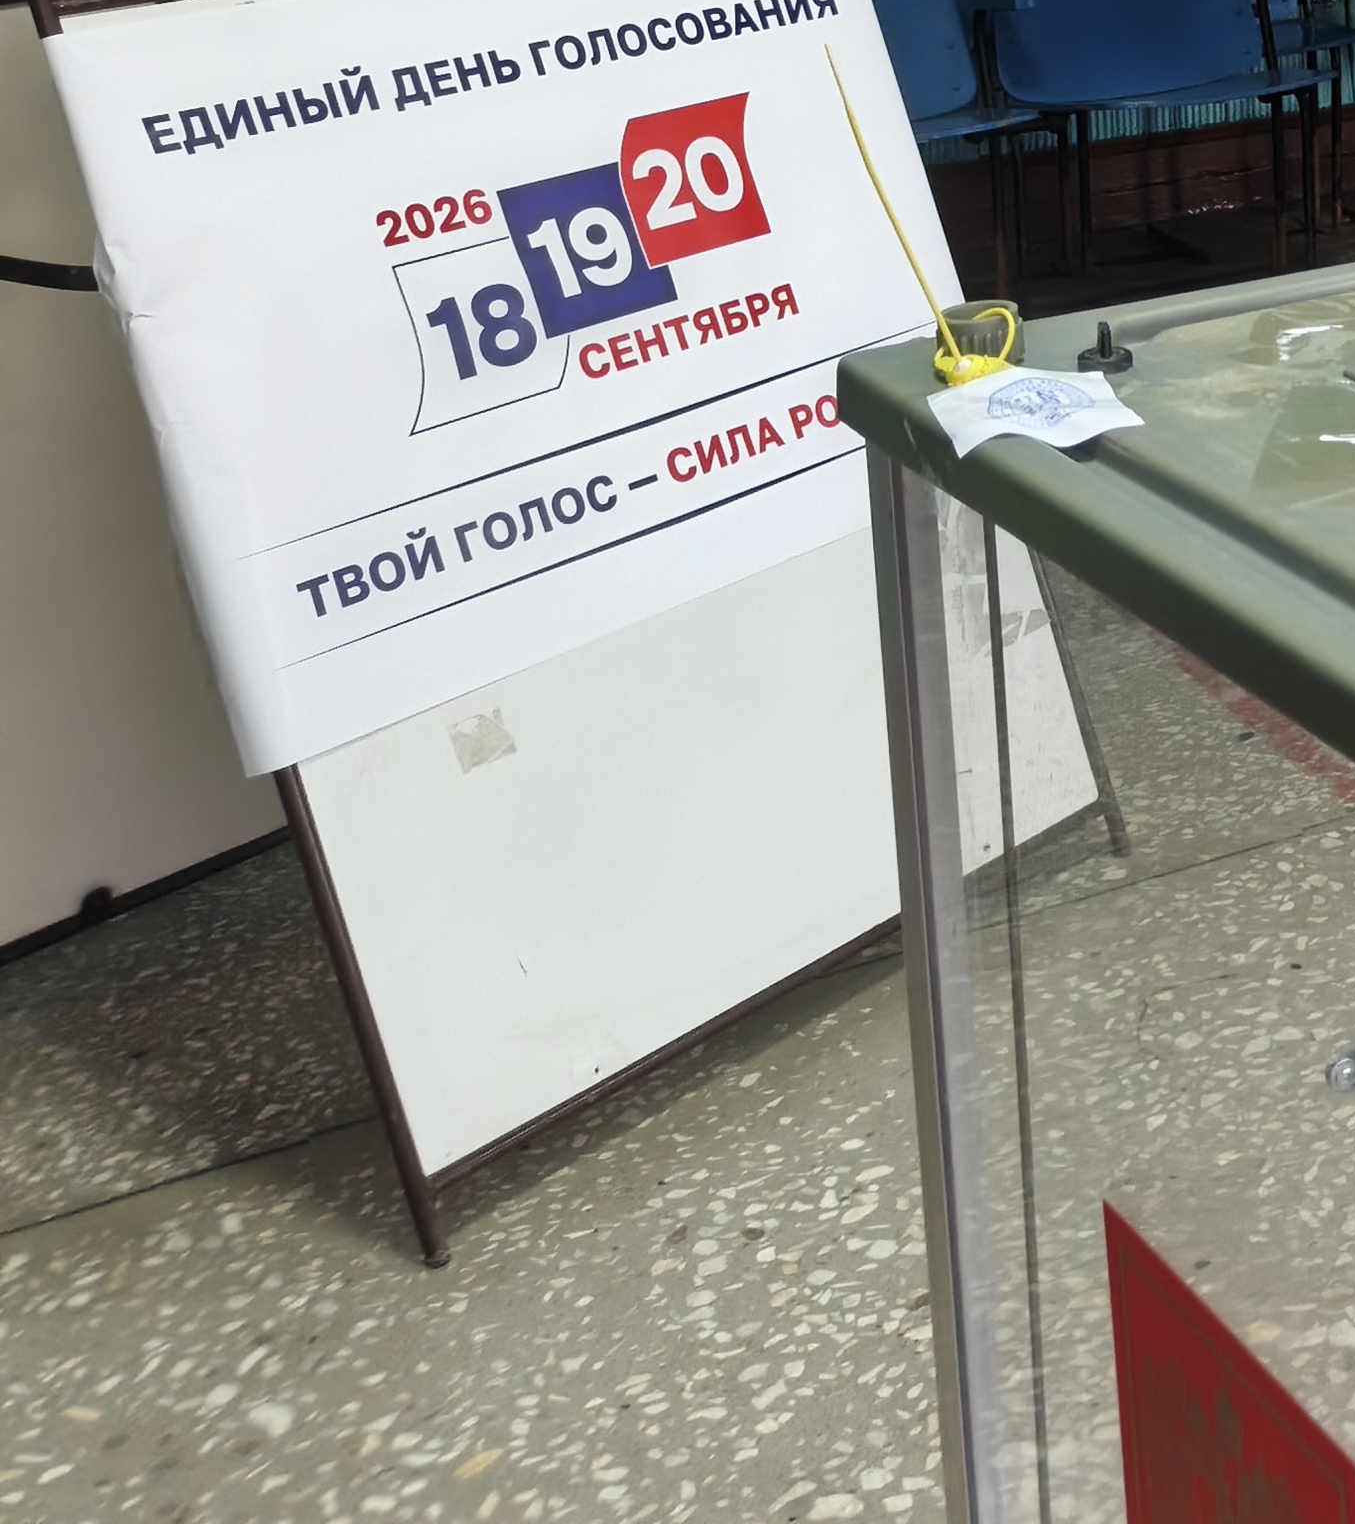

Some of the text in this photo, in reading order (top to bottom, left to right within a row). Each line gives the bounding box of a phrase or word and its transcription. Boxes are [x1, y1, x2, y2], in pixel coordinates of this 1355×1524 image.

[142, 66, 379, 154] ЕДИНЫЙ
[392, 51, 520, 111] ДЕНЬ
[377, 190, 492, 246] 2026
[426, 137, 743, 381] 18 19 20
[578, 283, 799, 379] СЕНТЯБРЯ
[296, 527, 444, 617] ТВОЙ
[454, 476, 617, 562] ГОЛОС
[667, 417, 785, 482] СИЛА
